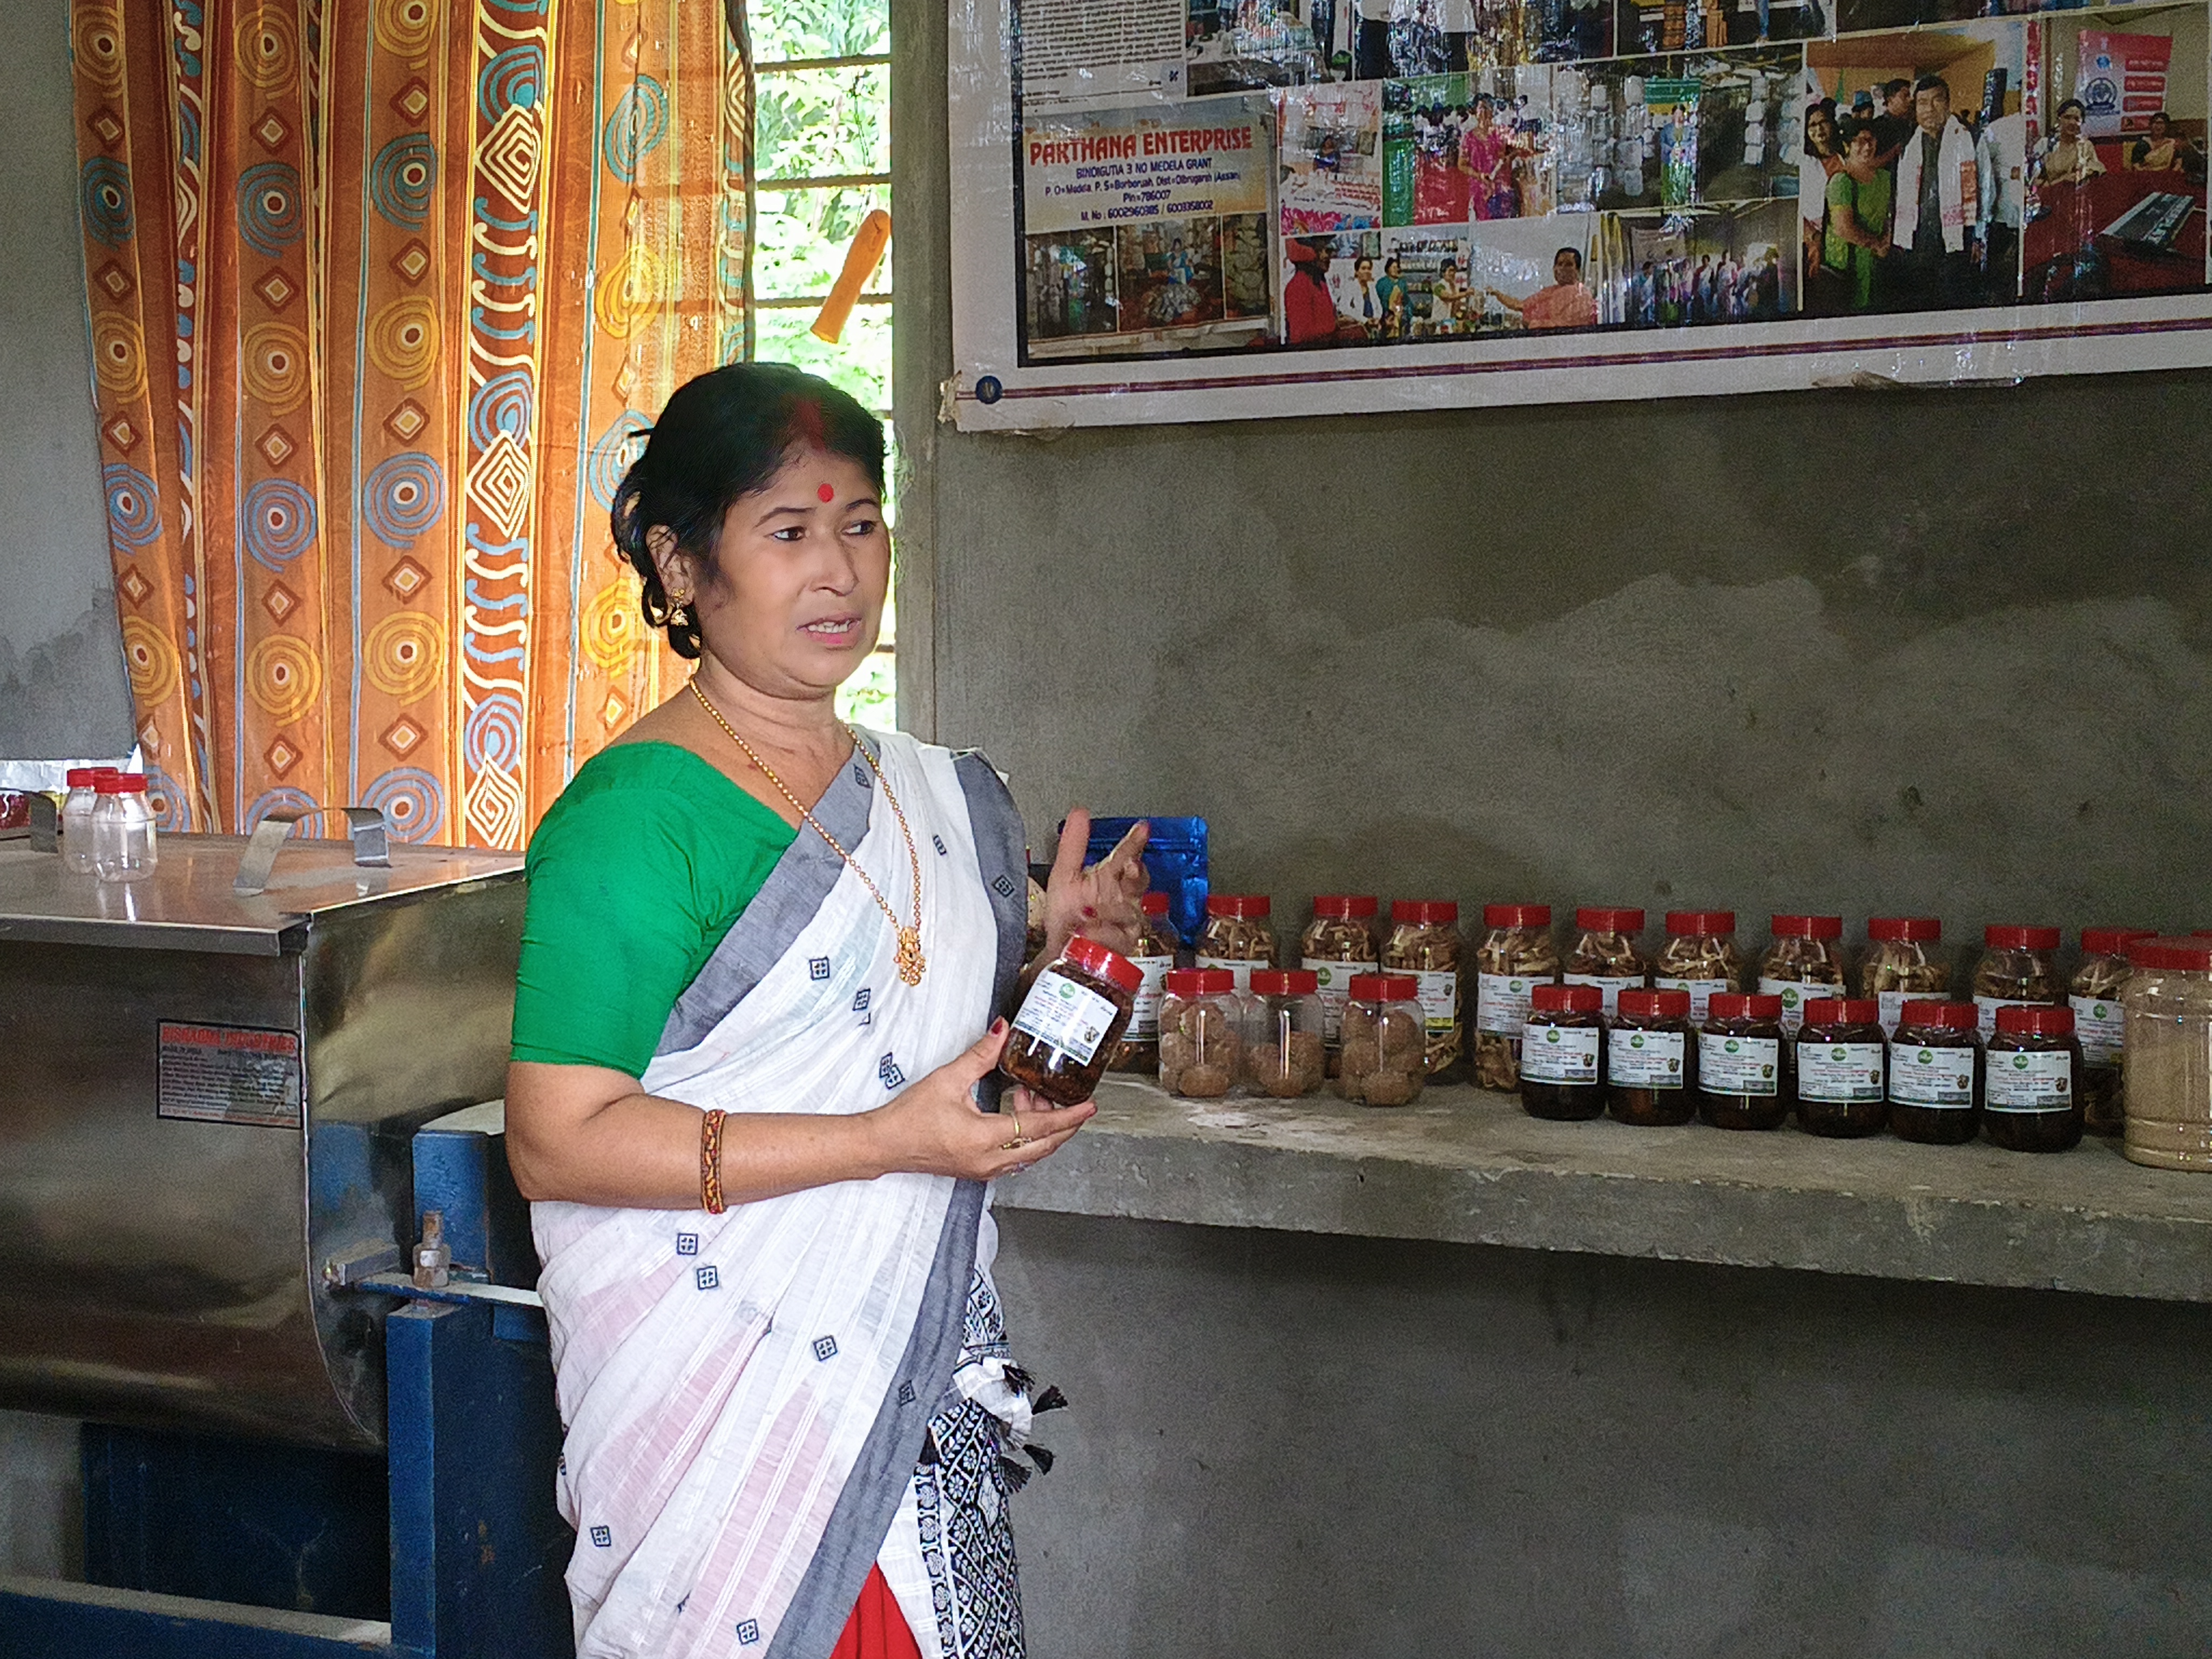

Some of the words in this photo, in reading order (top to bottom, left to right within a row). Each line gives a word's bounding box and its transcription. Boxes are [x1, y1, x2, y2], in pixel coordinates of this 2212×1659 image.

[1030, 134, 1136, 167] PARTHANA
[1143, 126, 1252, 156] ENTERPRISE
[1127, 163, 1132, 174] 3
[1136, 162, 1147, 173] NO
[1186, 158, 1212, 170] GRANT
